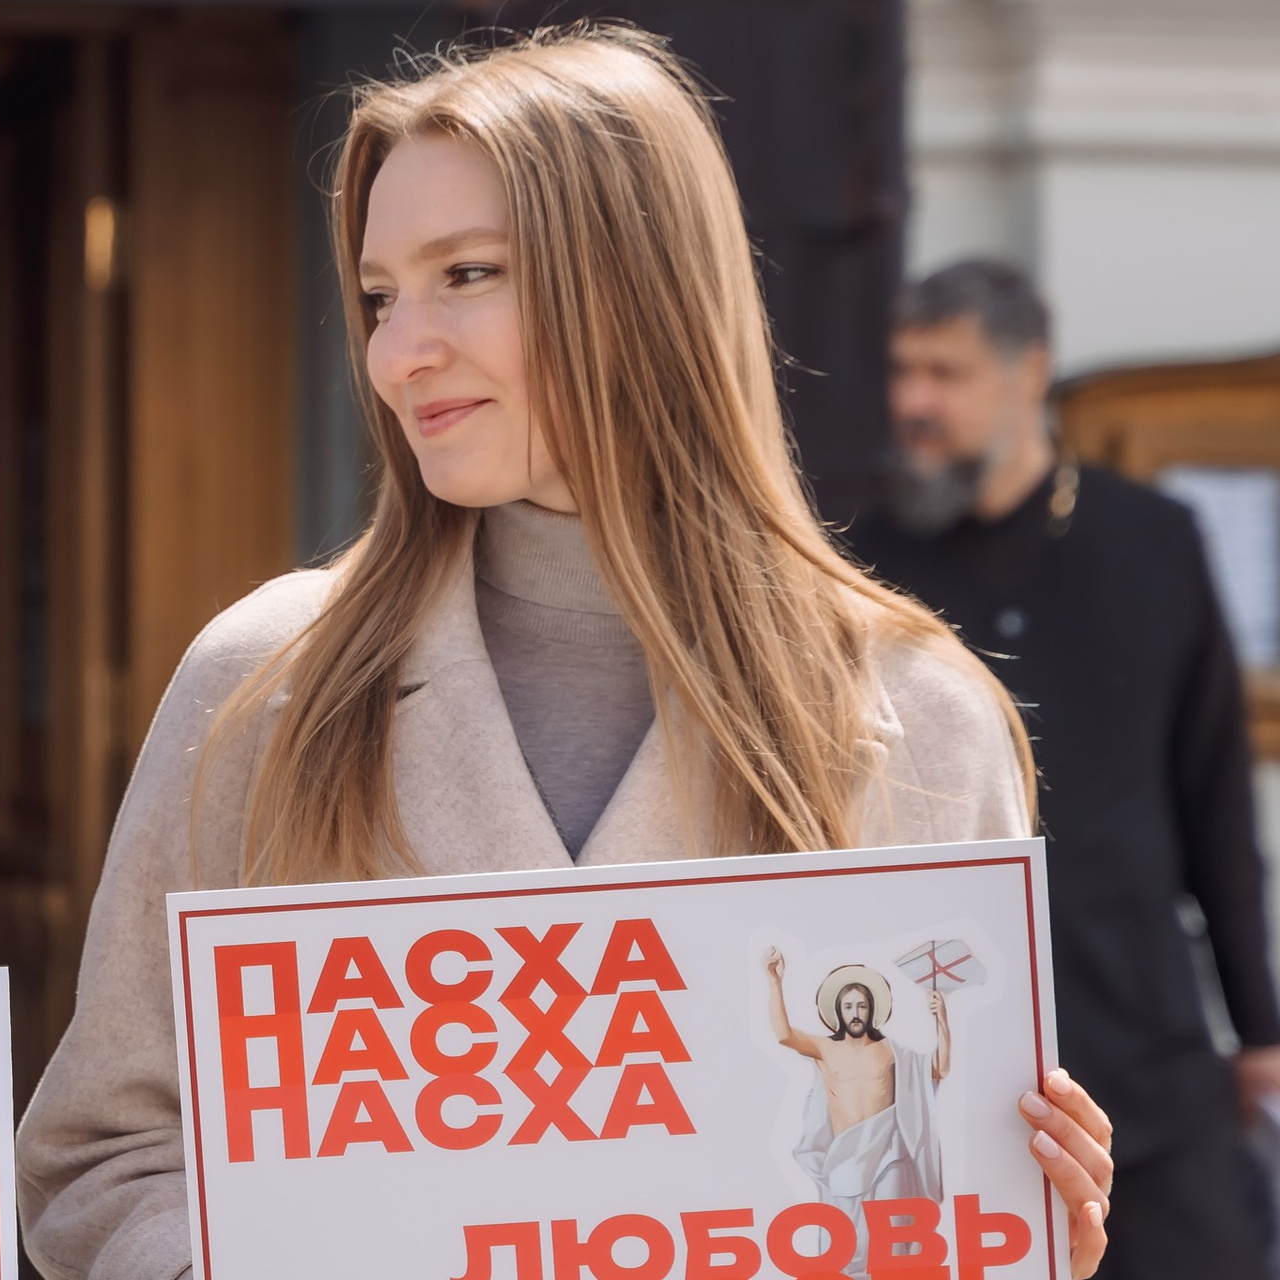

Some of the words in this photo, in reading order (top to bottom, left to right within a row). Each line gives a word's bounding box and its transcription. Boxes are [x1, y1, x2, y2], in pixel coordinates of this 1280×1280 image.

[214, 918, 687, 1017] ПАСХА
[220, 991, 692, 1091] ПАСХА
[224, 1062, 696, 1163] ПАСХА
